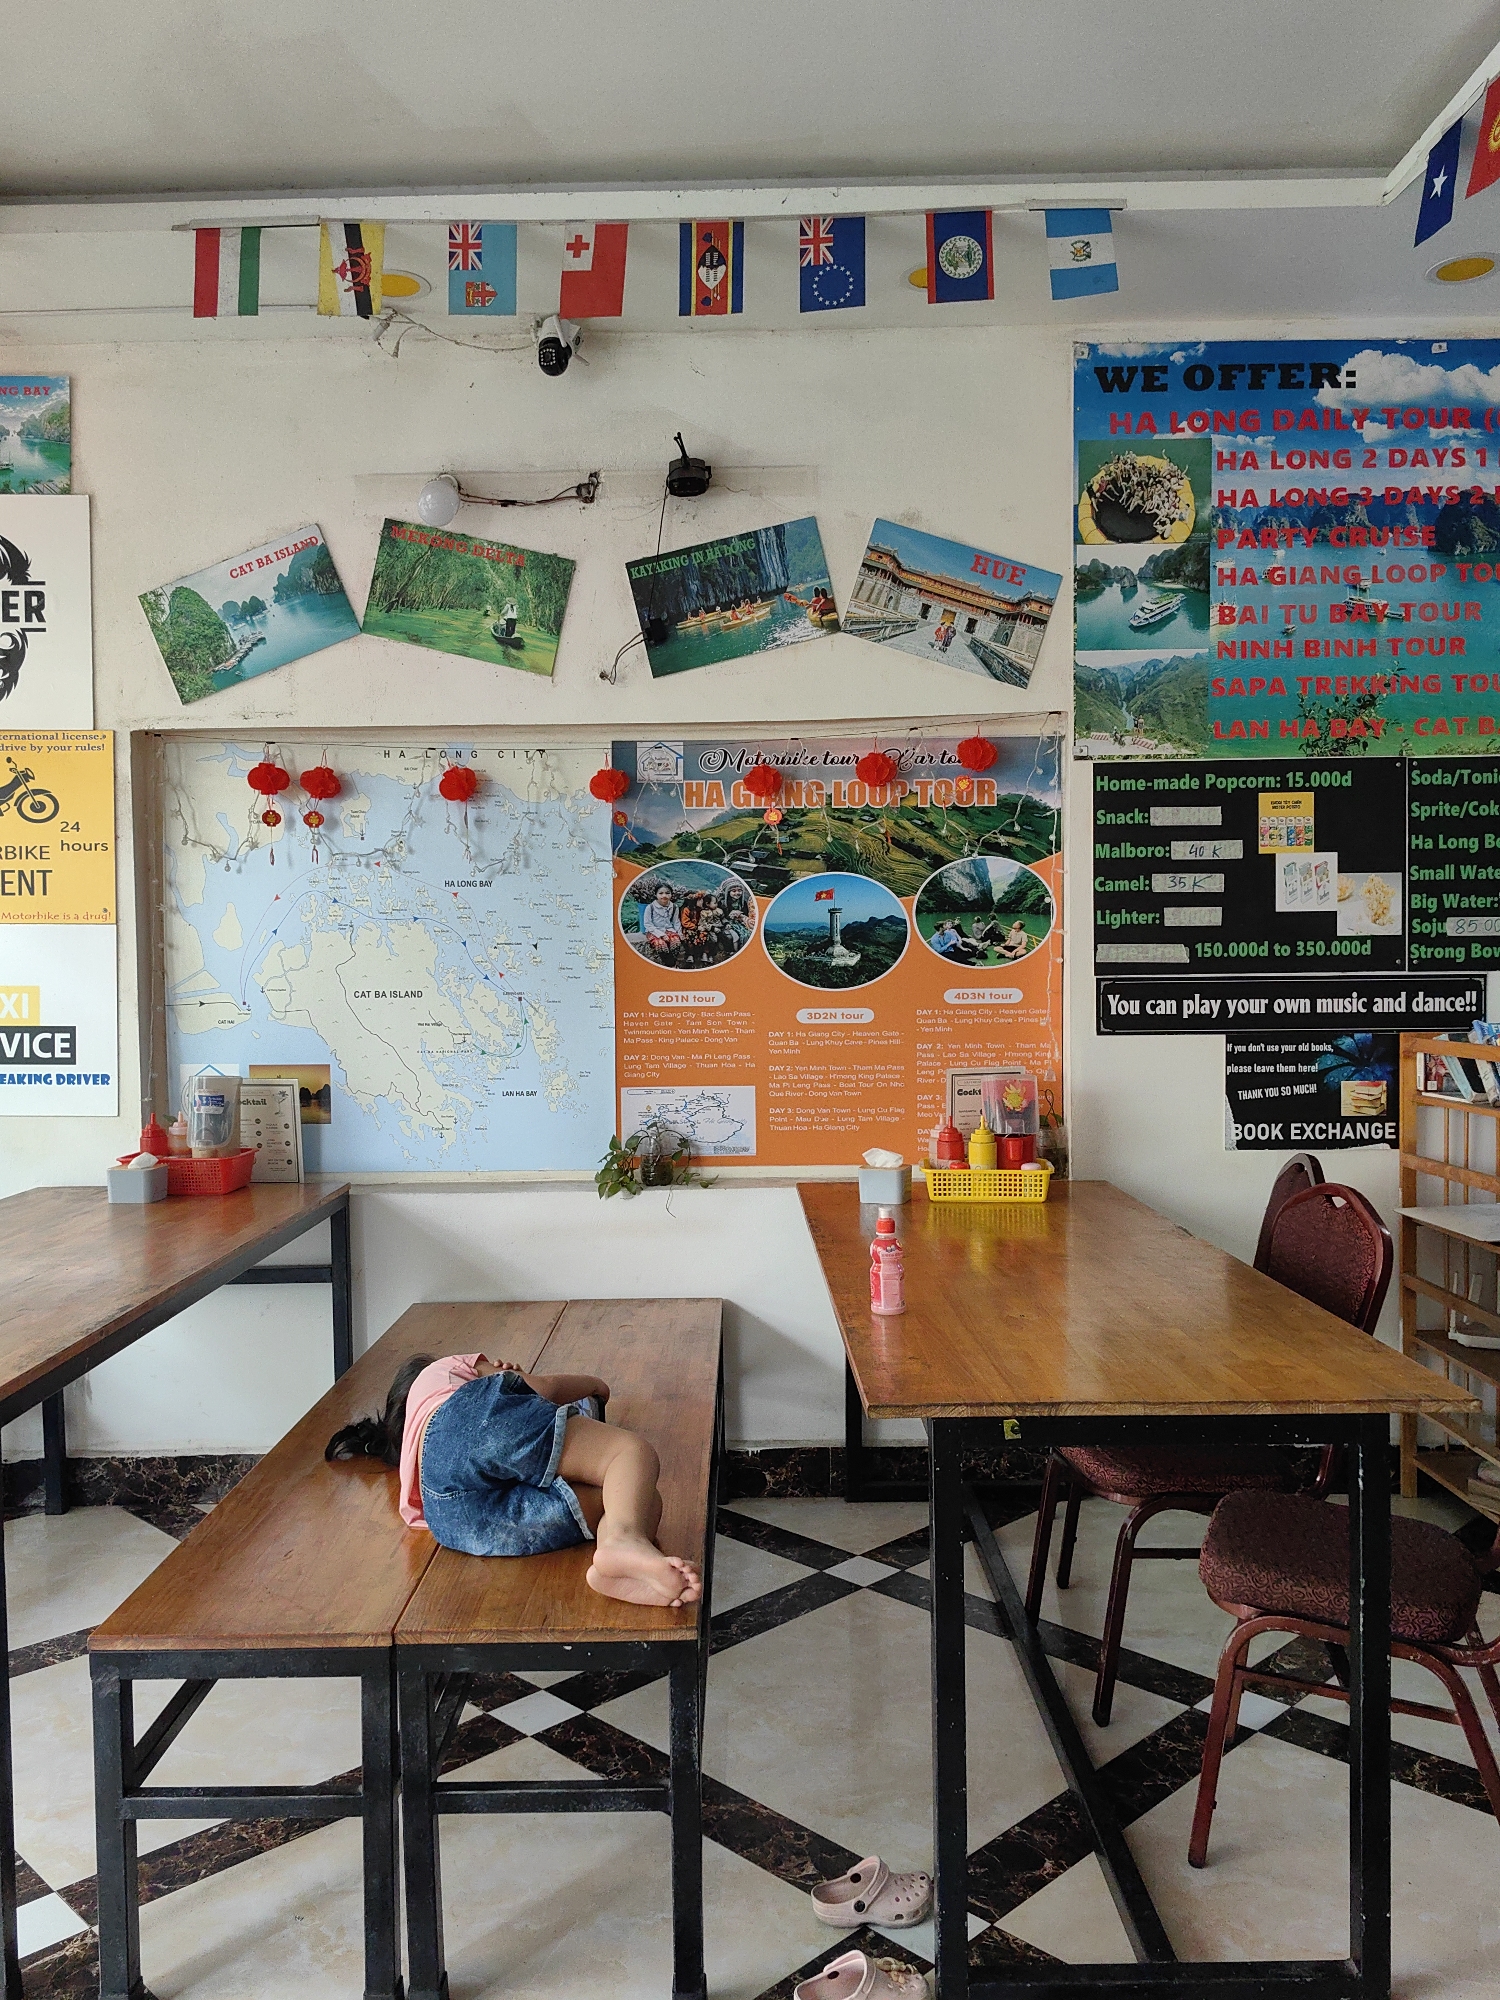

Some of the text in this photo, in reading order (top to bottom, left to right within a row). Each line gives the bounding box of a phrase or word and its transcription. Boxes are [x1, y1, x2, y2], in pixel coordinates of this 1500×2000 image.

[1093, 362, 1357, 394] WE OFFER:
[23, 386, 51, 396] BAY
[1109, 407, 1472, 435] HA LONG DAILY TOUR
[1216, 451, 1259, 471] HA
[1271, 449, 1352, 471] LONG
[1362, 448, 1377, 469] 2
[1388, 447, 1466, 468] DAYS
[1475, 447, 1488, 468] 1
[1217, 489, 1259, 509] HA
[1270, 488, 1349, 508] LONG
[1359, 487, 1373, 507] 3
[1384, 485, 1461, 505] DAYS
[1469, 485, 1484, 505] 2
[390, 525, 526, 567] MEKONG DELTA
[1217, 525, 1436, 550] PARTY CRUISE
[229, 536, 319, 579] CAT BA ISLAND
[630, 555, 689, 579] KAYAKING
[690, 552, 705, 565] IN
[706, 545, 722, 561] HA
[969, 553, 1027, 586] HUE
[1217, 566, 1259, 587] HA
[1270, 565, 1362, 586] GIANG
[1371, 563, 1446, 584] LOOP
[1218, 601, 1482, 625] BAI TU BAY TOUR
[1217, 636, 1466, 659] NINH BINH TOUR
[1211, 676, 1286, 697] SAPA
[1296, 674, 1442, 696] TREKKING
[1213, 716, 1470, 739] LAN HA BAY CAT
[30, 743, 43, 753] by
[47, 745, 72, 753] your
[75, 743, 105, 751] rules!
[384, 751, 544, 759] HA LONG CITY
[1095, 770, 1352, 793] Home-made Popcorn: 15.000d
[1411, 767, 1500, 787] Soda/Toni
[684, 780, 726, 809] HA
[831, 779, 909, 809] LOOP
[913, 778, 998, 808] TOUR
[1096, 807, 1149, 825] Snack:
[1411, 799, 1500, 821] Sprite/Cok
[60, 821, 80, 832] 24
[0, 845, 50, 860] BIKE
[60, 839, 109, 851] hours
[1095, 842, 1170, 859] Malboro:
[1188, 844, 1223, 859] 40 K
[1411, 833, 1479, 854] Ha Long
[1410, 863, 1455, 881] Small
[444, 880, 493, 888] HA LONG BAY
[1094, 875, 1150, 892] Camel:
[1167, 874, 1213, 892] 35 K
[1410, 893, 1499, 914] Big Water:
[1, 911, 60, 920] Motorbike
[63, 912, 71, 920] is
[82, 911, 112, 923] drug!
[1096, 909, 1160, 930] Lighter:
[1194, 939, 1371, 958] 150.000d to 350.000d
[1410, 943, 1466, 963] Strong
[353, 990, 423, 998] CAT BA ISLAND
[658, 994, 716, 1003] 2D1N tour
[954, 992, 1013, 1000] 4D3N tour
[1107, 990, 1477, 1019] You can play your own music and dance!!
[806, 1012, 865, 1020] 3D2N tour
[1227, 1042, 1334, 1054] If you don't use your old books,
[1226, 1062, 1318, 1075] please leave them here!
[56, 1073, 110, 1085] DRIVER
[1237, 1083, 1318, 1101] THANK YOU SO MUCH!
[1231, 1121, 1397, 1141] BOOK EXCHANGE
